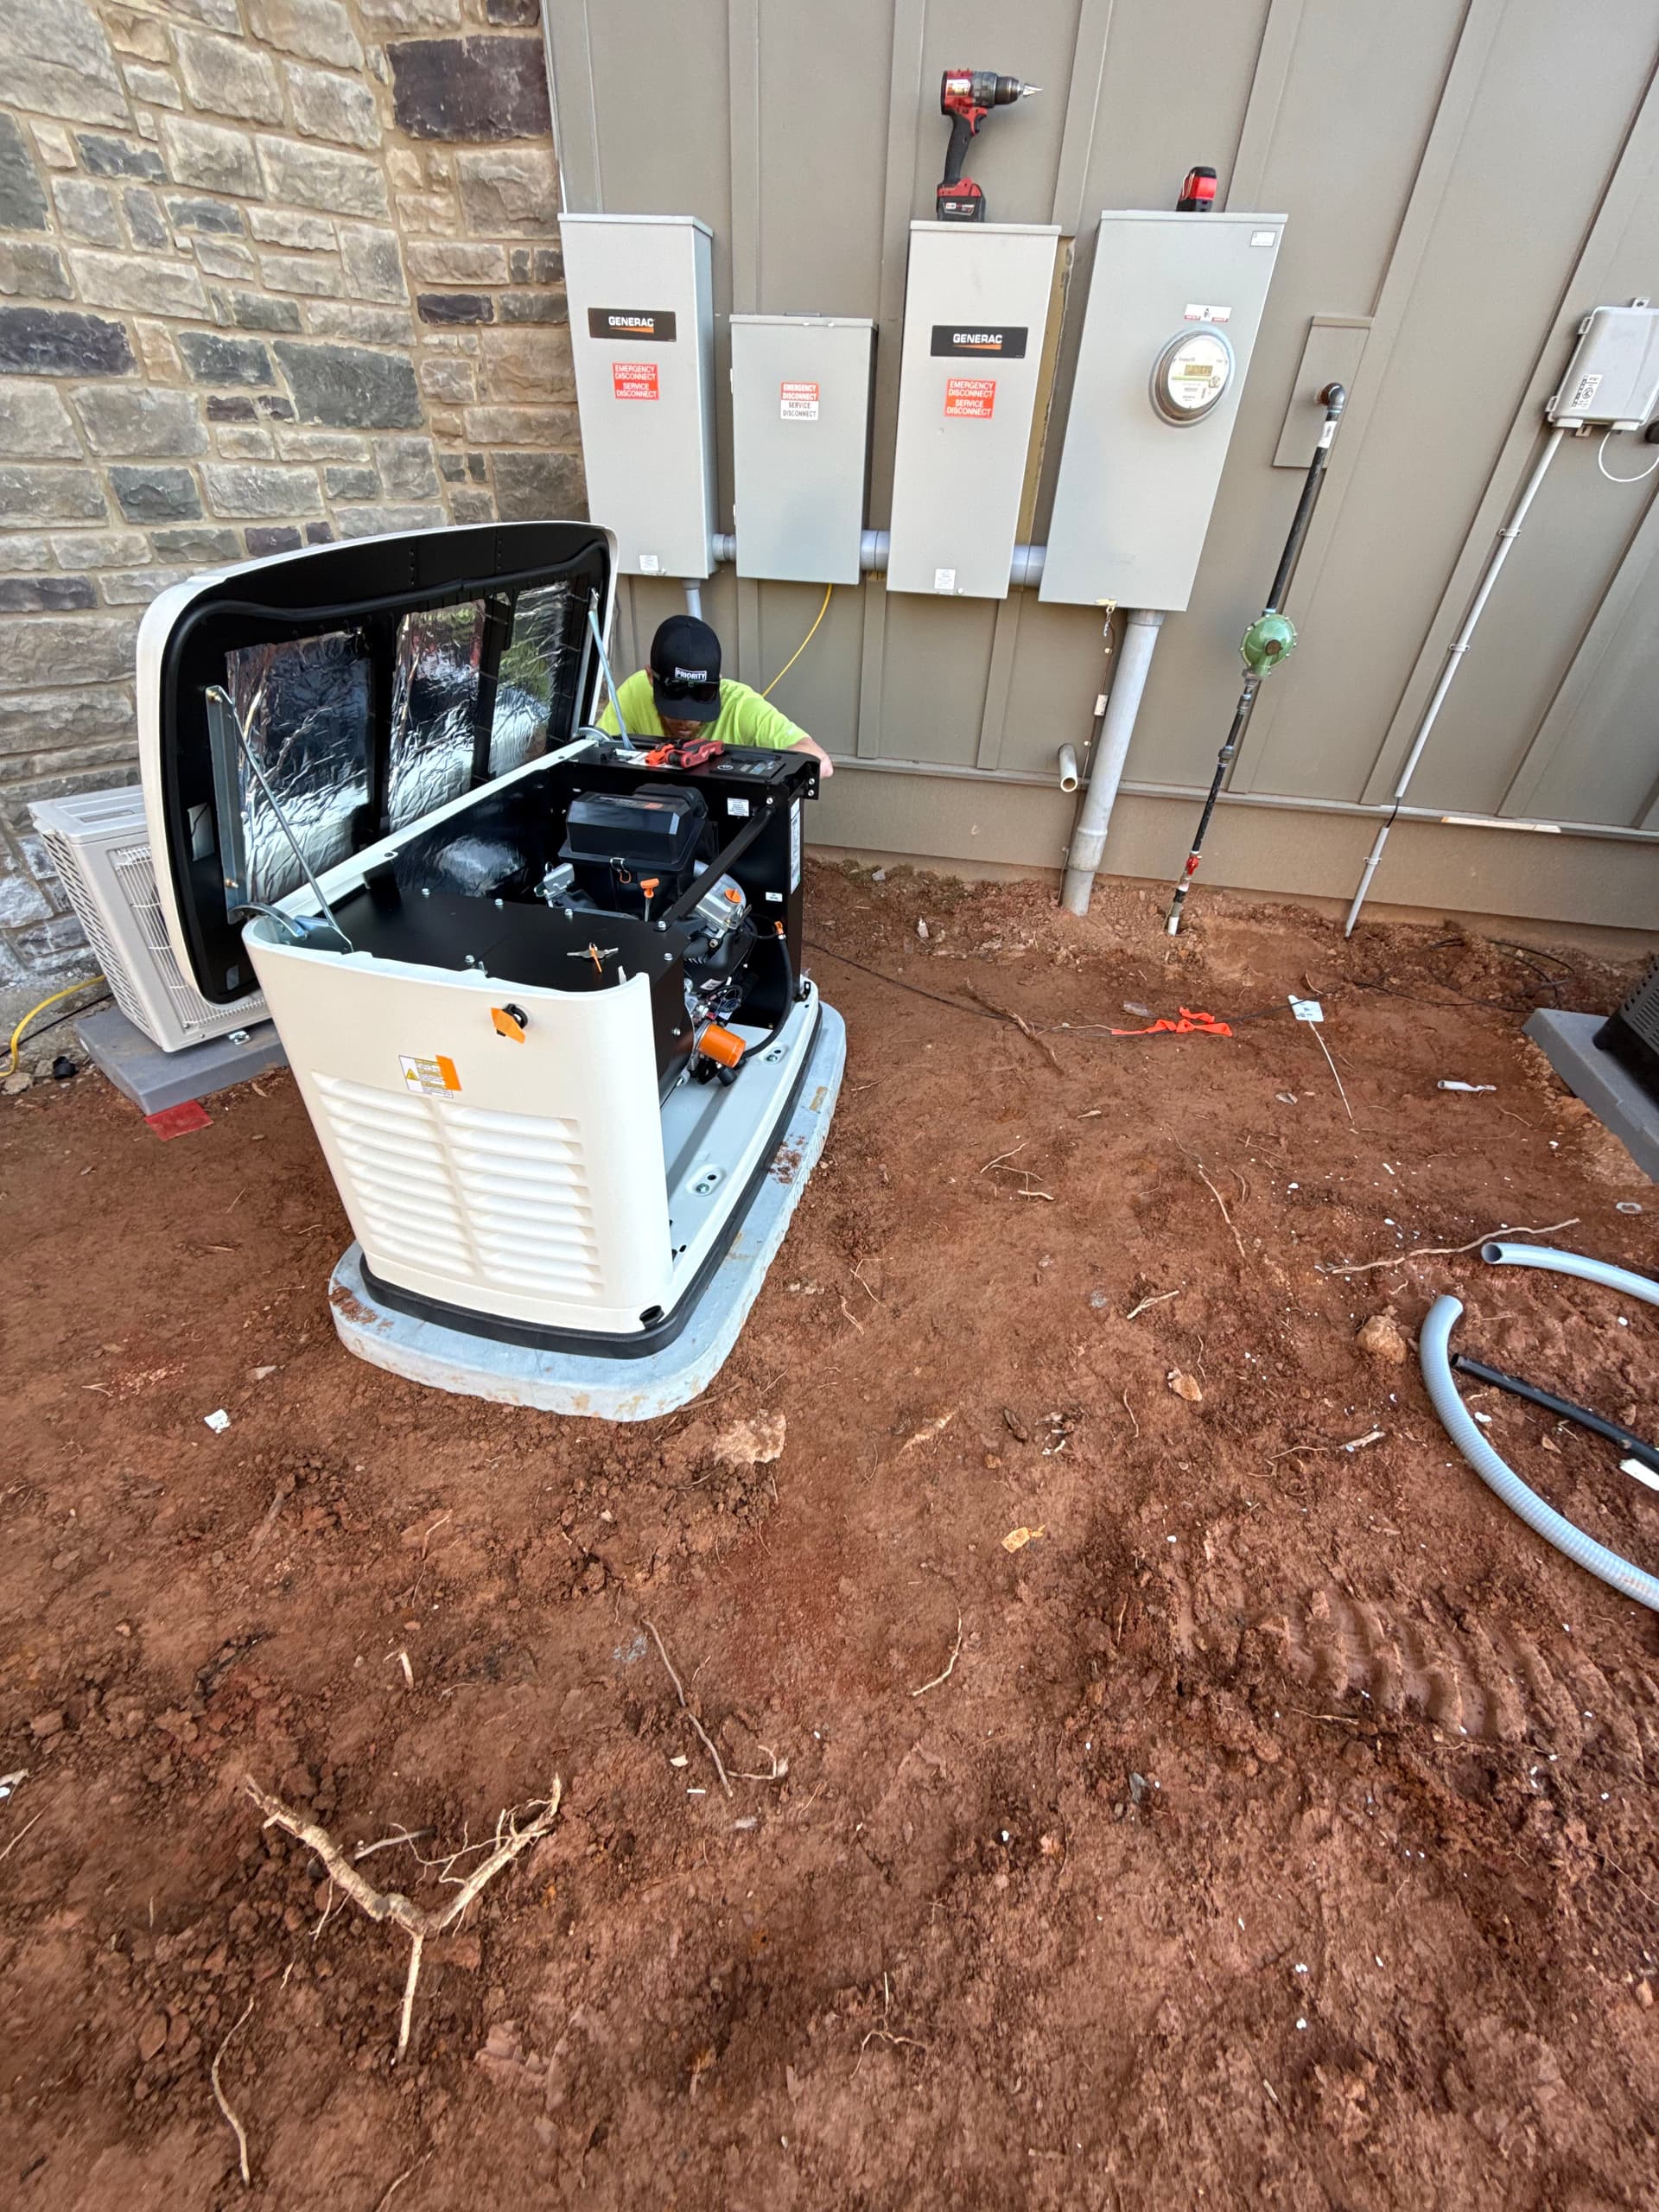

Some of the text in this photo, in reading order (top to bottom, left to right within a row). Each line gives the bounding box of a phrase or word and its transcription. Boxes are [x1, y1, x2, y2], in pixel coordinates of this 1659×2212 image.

[608, 316, 654, 327] GENERAC
[953, 334, 1002, 344] GENERAC
[949, 380, 994, 389] EMERGENCY
[948, 388, 993, 397] DISCONNECT
[946, 406, 992, 416] DISCONNECT
[677, 670, 706, 680] PRIORITY
